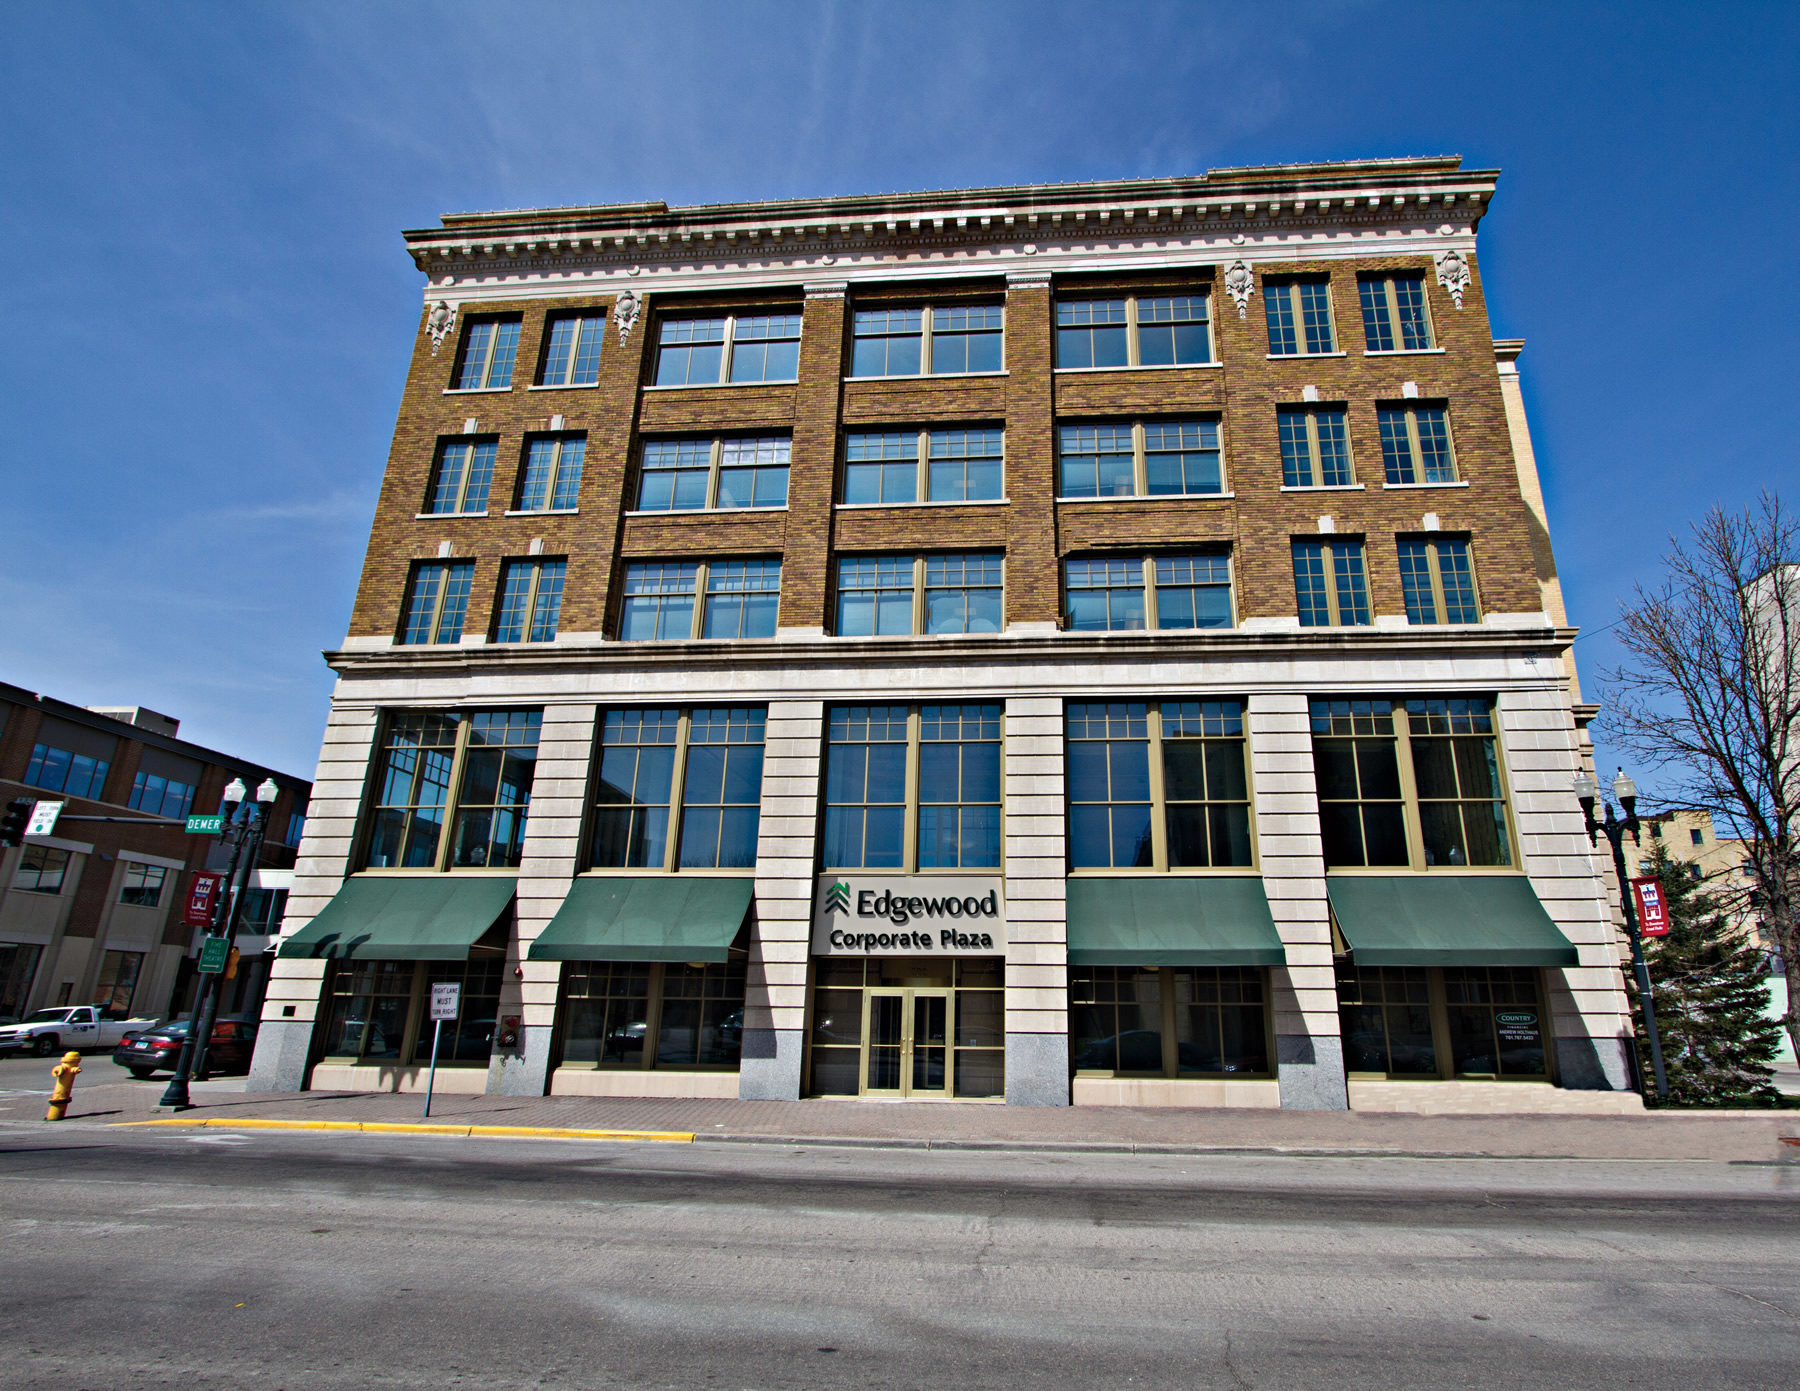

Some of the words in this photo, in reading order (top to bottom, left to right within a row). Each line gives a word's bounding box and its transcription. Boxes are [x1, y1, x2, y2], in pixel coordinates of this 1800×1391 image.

[187, 818, 223, 830] DEMER
[857, 889, 997, 923] Edgewood
[830, 929, 932, 951] Corporate
[940, 928, 992, 947] Plaza
[437, 997, 452, 1005] MUST
